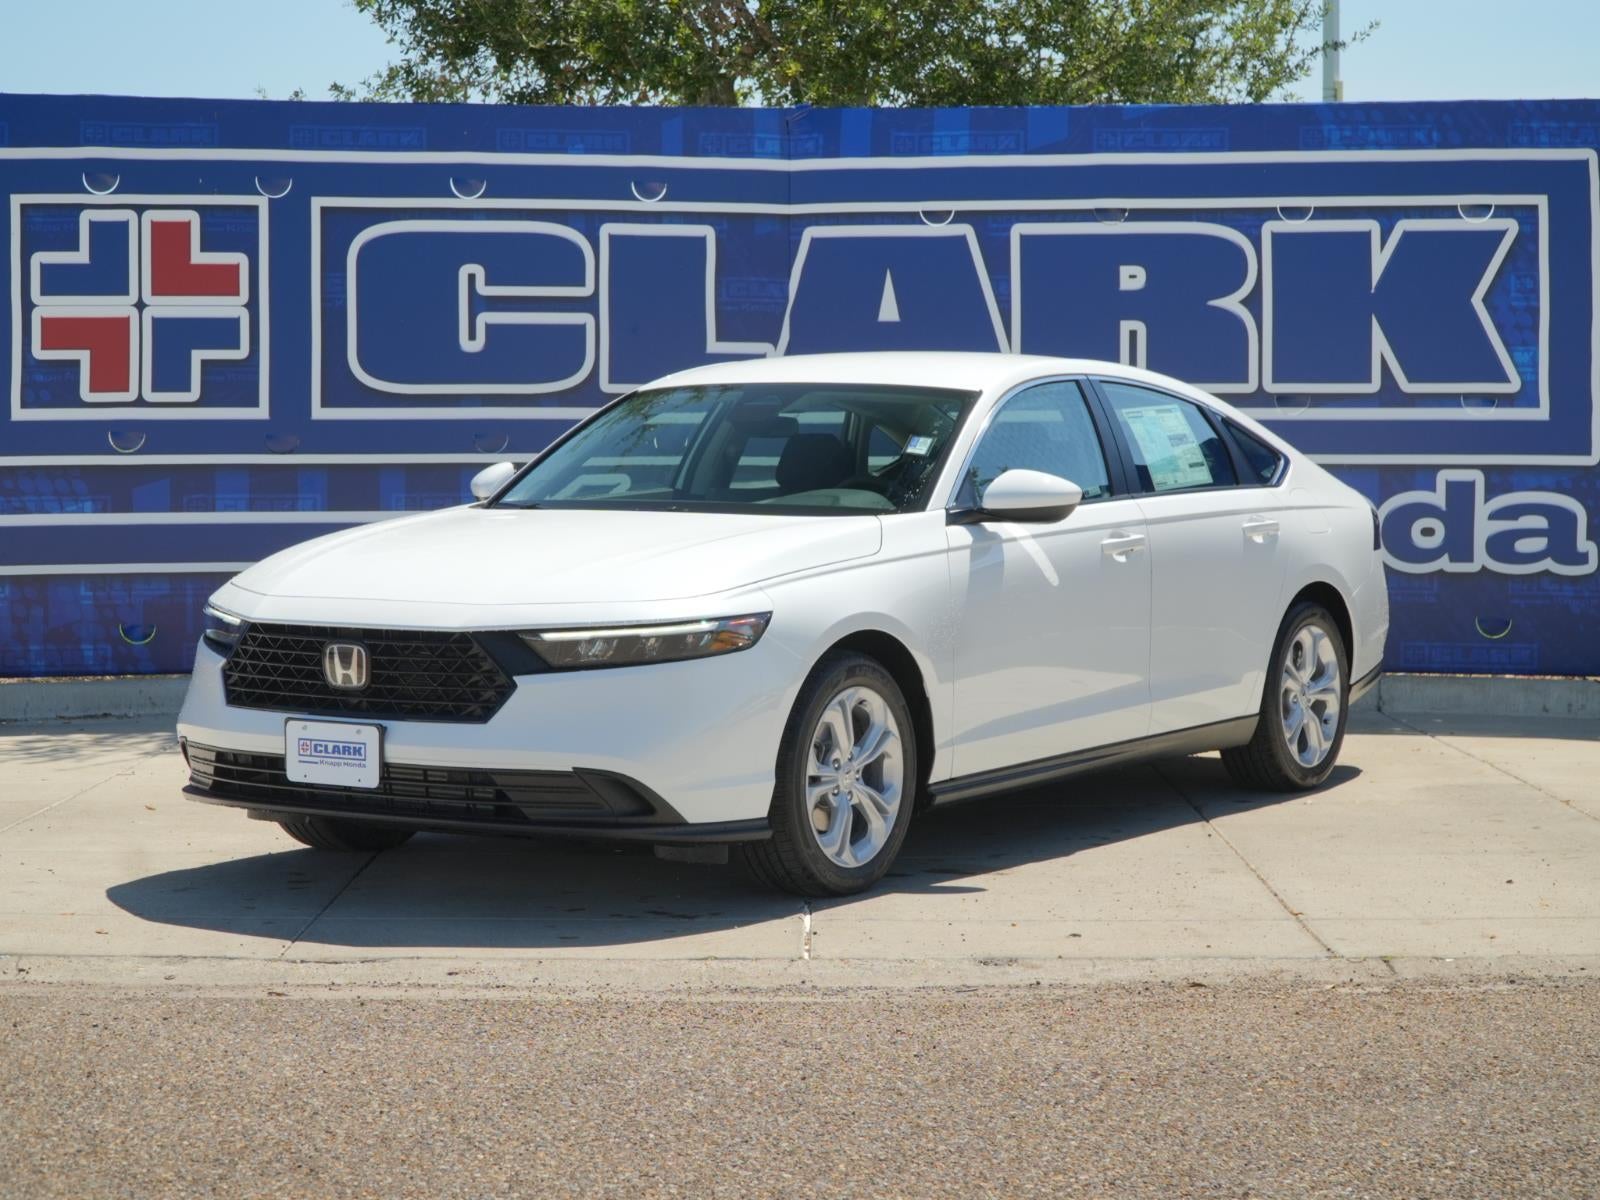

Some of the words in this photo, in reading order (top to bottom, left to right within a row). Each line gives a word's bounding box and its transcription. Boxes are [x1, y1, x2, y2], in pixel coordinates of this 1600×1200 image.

[347, 218, 1521, 394] CLARK
[313, 743, 363, 757] CLARK
[319, 759, 342, 768] Knapp
[343, 761, 367, 769] Honda
